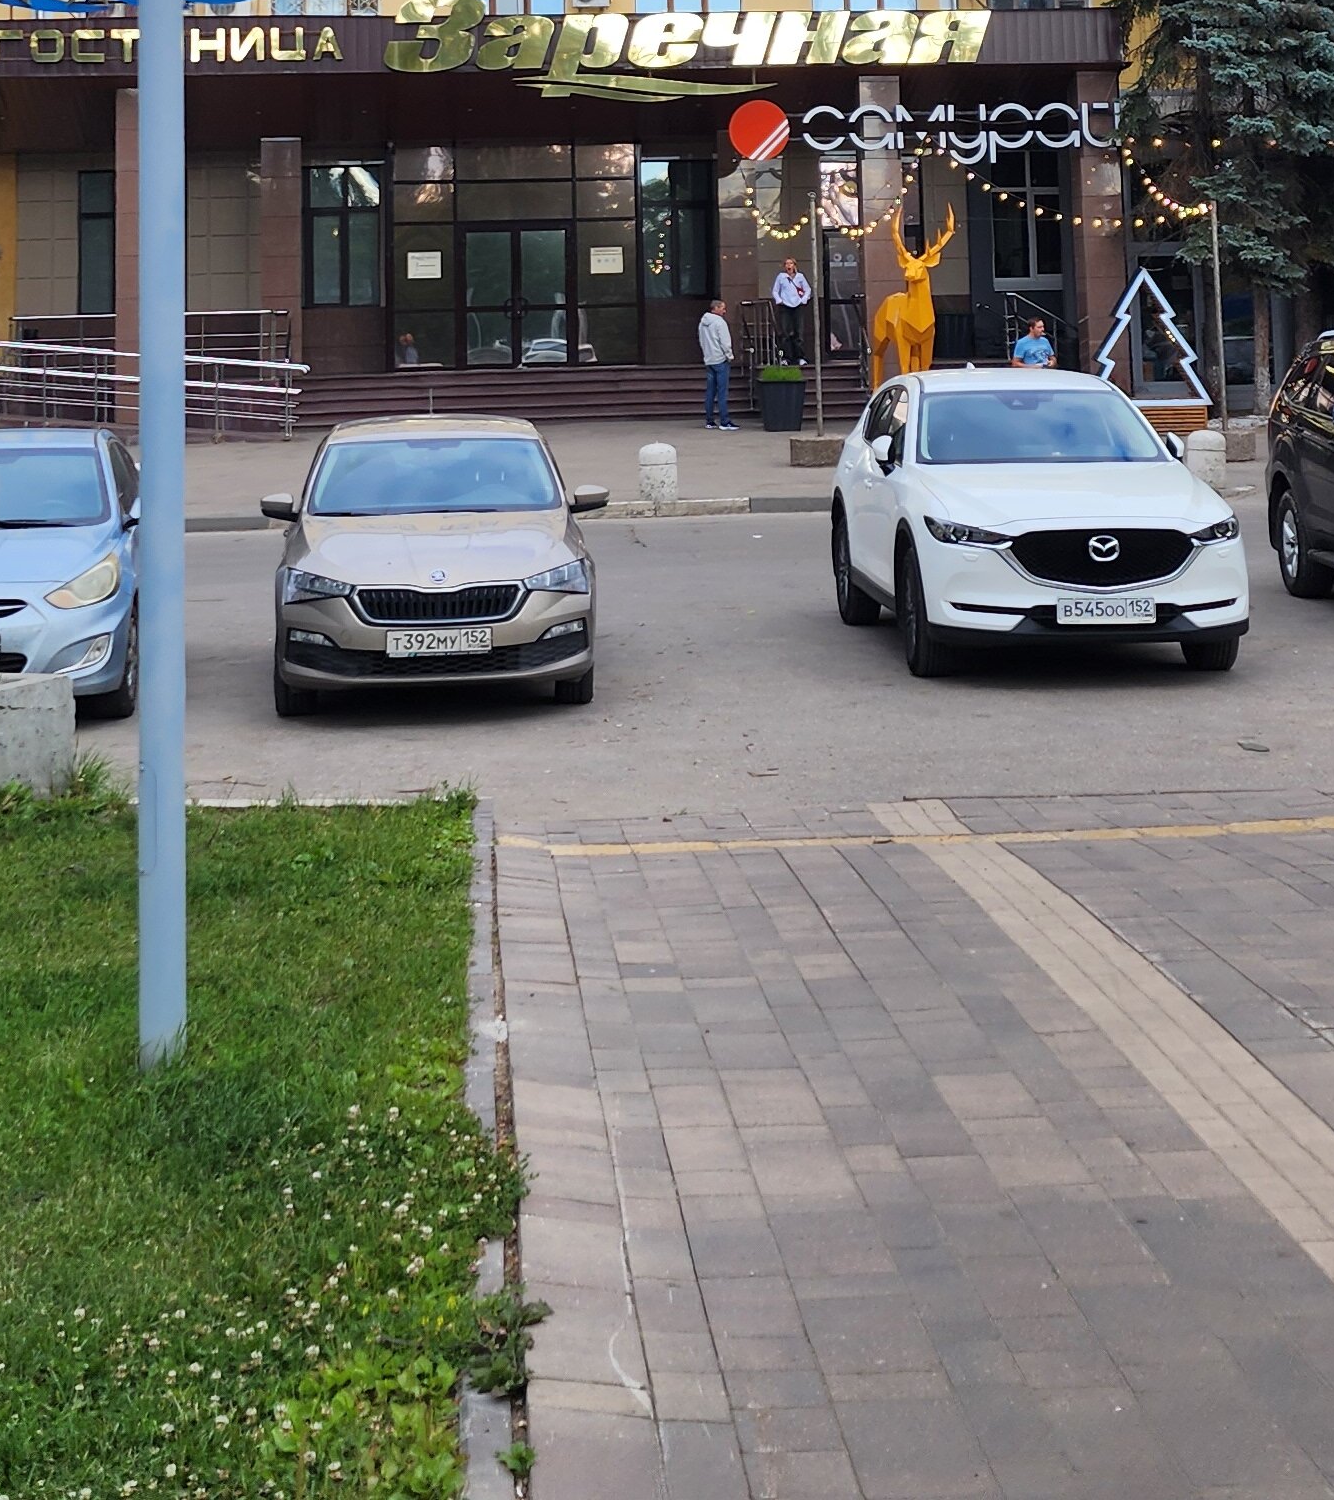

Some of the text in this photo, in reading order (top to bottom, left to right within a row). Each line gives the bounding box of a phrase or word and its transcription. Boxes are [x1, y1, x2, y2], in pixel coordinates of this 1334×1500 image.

[1063, 600, 1151, 617] В545ОО 152
[392, 629, 488, 650] Т392МУ 152
